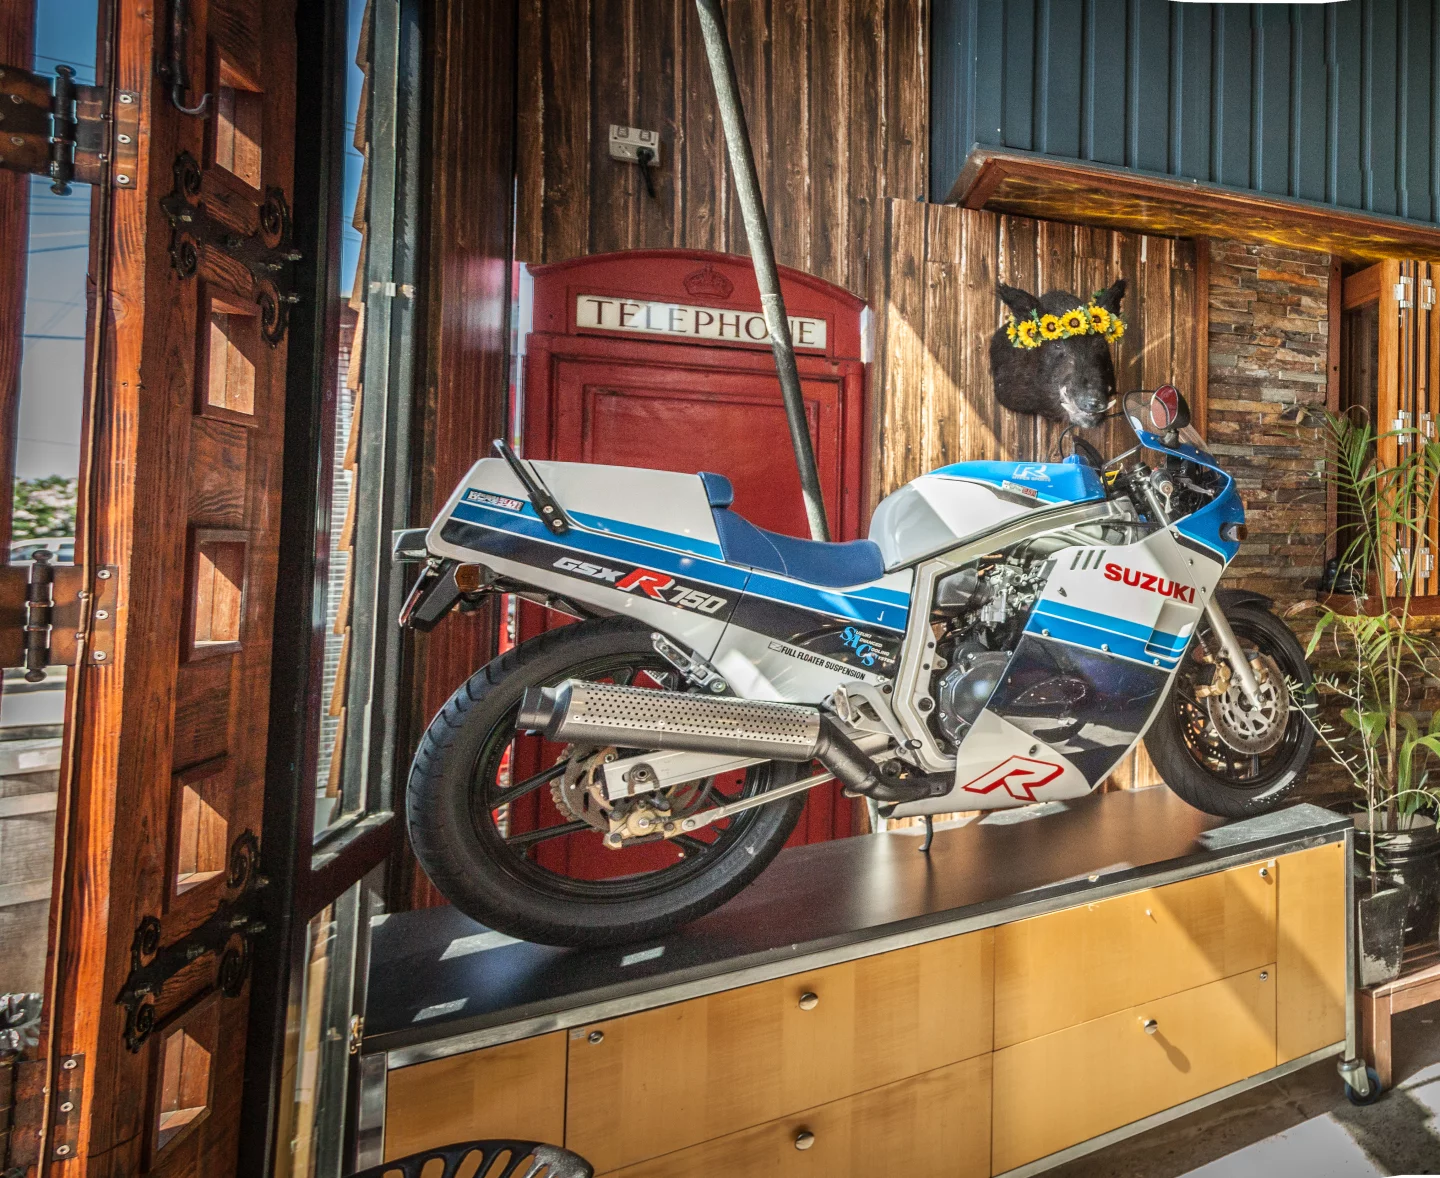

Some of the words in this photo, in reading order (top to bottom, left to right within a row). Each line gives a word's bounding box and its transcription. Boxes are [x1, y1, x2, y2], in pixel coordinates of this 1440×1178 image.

[1104, 563, 1195, 603] SUZUKI
[781, 646, 796, 658] FULL
[797, 651, 825, 667] FLOATER
[825, 661, 866, 680] SUSPENSION
